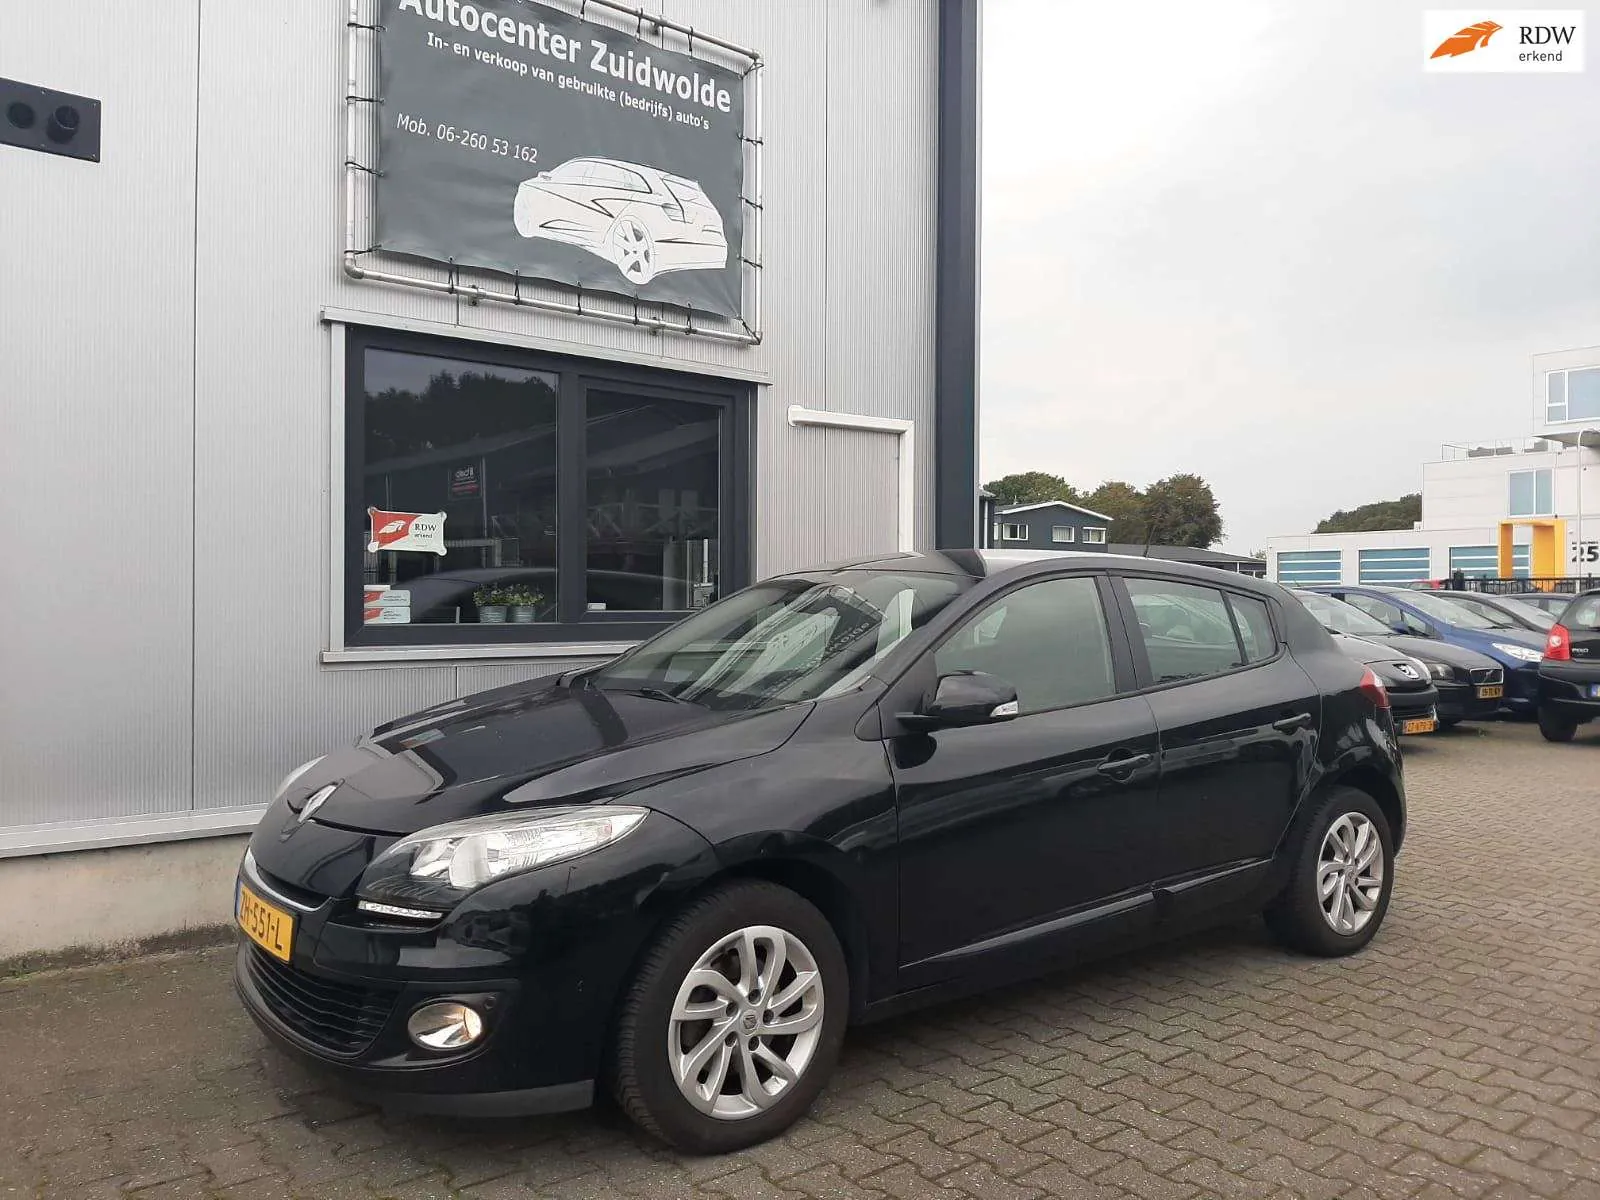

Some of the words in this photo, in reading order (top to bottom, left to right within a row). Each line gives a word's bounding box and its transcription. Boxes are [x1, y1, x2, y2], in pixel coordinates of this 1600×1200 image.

[427, 31, 449, 49] In-
[453, 42, 470, 57] en
[474, 48, 528, 76] verkoop
[531, 65, 554, 83] van
[558, 74, 616, 102] gebruikte
[619, 90, 673, 121] (bedrijfs)
[676, 111, 710, 130] auto's
[590, 39, 731, 113] Zuidwolde
[396, 112, 431, 137] Mob.
[436, 124, 488, 150] 06-260
[491, 138, 509, 156] 53
[513, 144, 538, 163] 162
[414, 523, 437, 532] RDW
